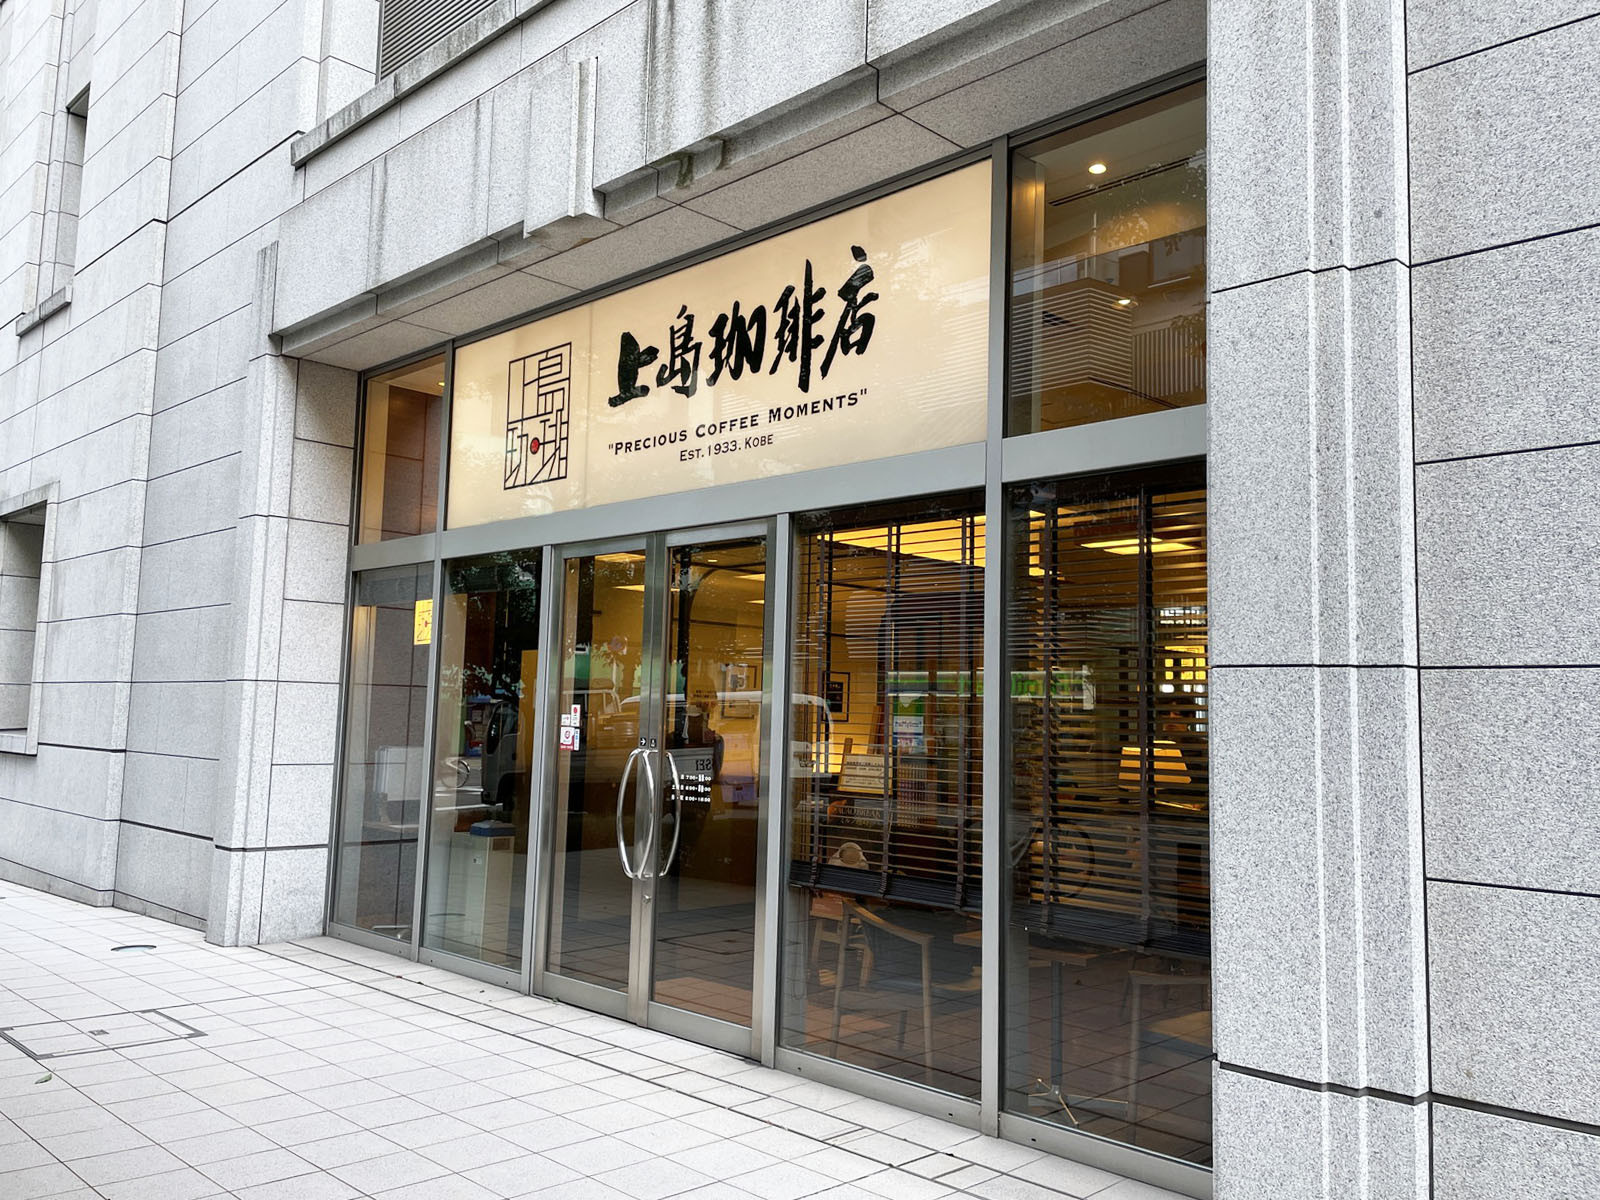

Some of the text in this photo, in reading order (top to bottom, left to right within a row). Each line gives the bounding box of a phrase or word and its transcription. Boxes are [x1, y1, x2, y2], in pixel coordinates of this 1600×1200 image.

[608, 245, 879, 407] 上島珈琲店
[608, 388, 868, 456] "PRECIOUS COFFEE MOMENTS"
[744, 434, 774, 449] KOBE
